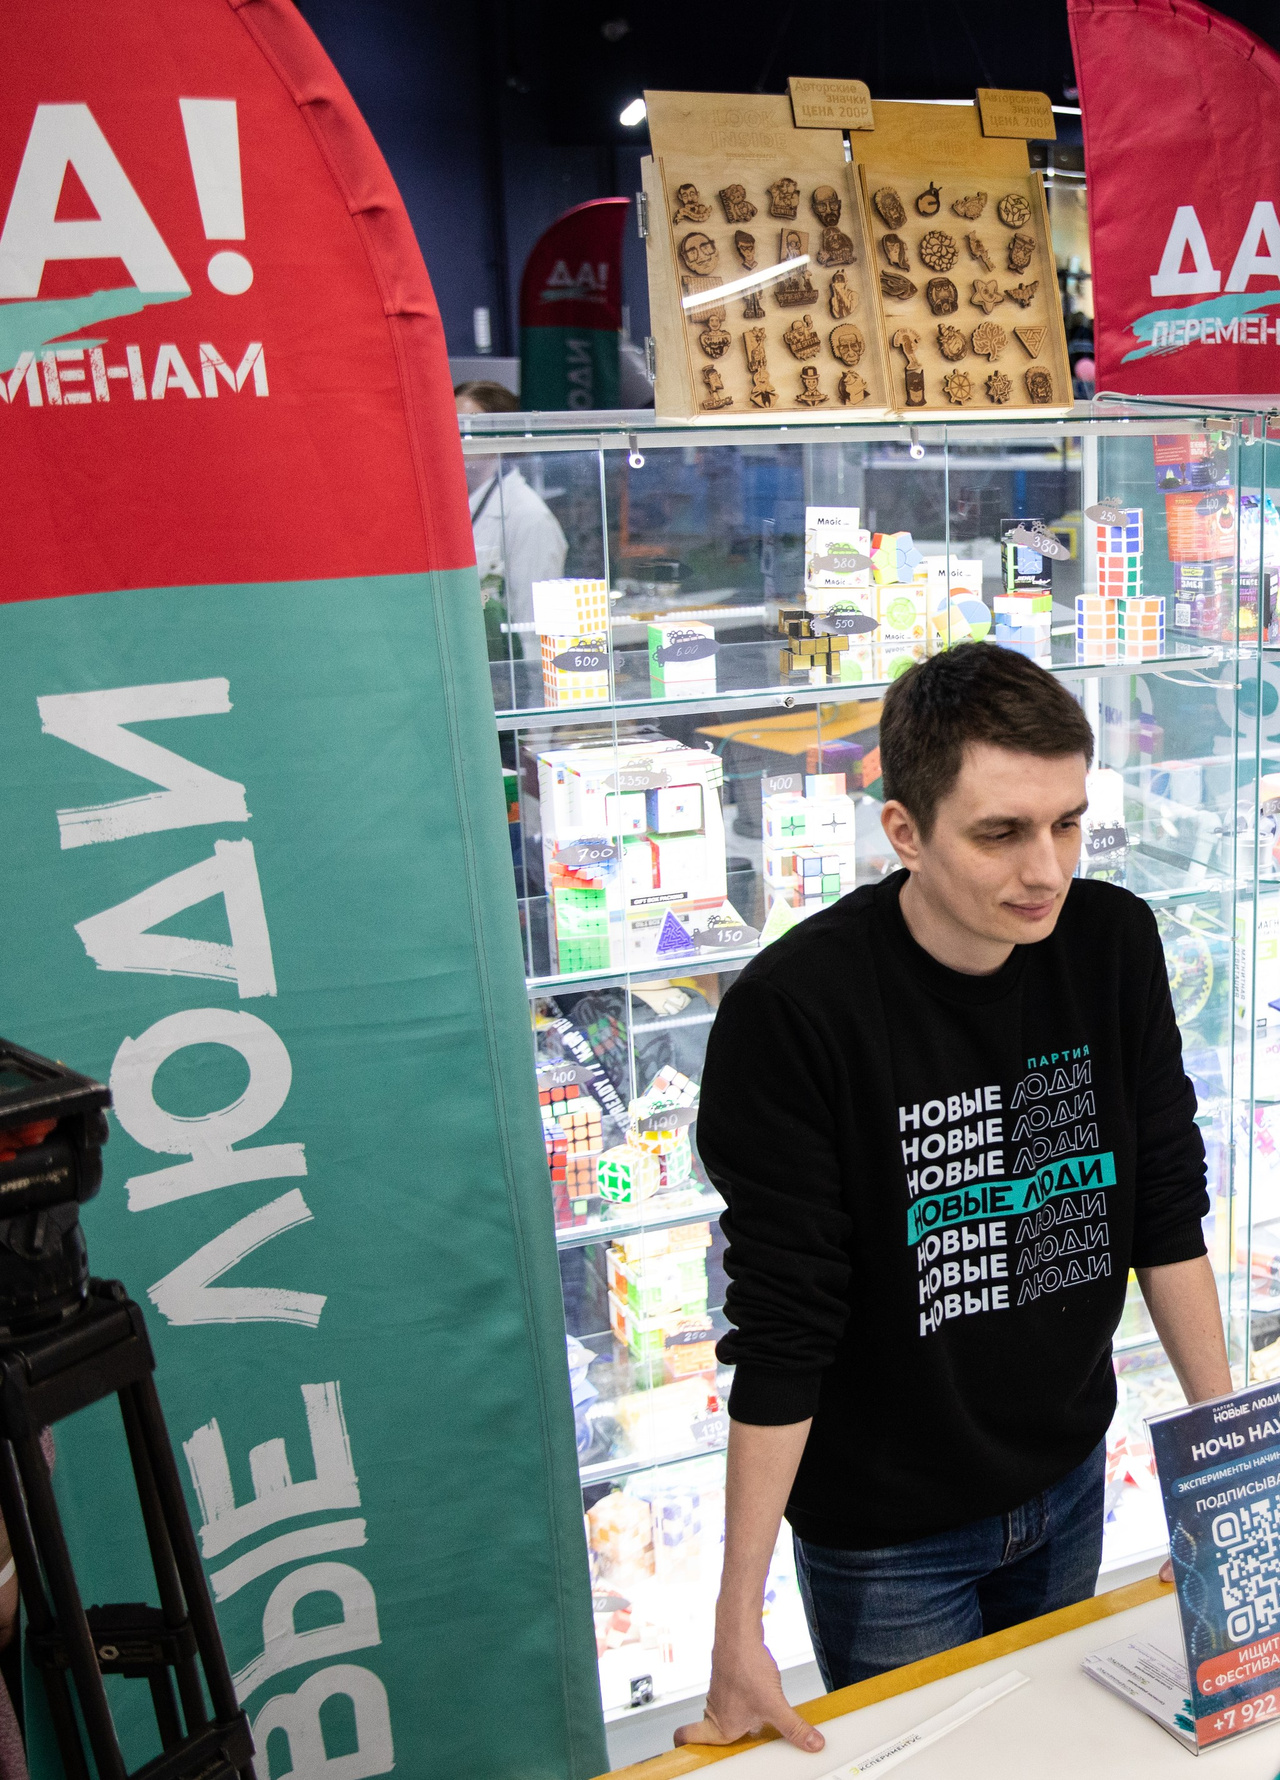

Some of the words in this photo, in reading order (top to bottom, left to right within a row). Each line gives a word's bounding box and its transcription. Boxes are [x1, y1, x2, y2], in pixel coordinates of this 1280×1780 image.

[795, 80, 857, 95] Авторские
[826, 95, 867, 105] значки
[802, 105, 834, 117] ЦЕНА
[990, 115, 1020, 128] ЦЕНА
[1100, 510, 1116, 522] 250
[1033, 536, 1058, 555] 380
[835, 619, 854, 628] 550
[769, 777, 792, 790] 400
[1093, 836, 1115, 849] 610
[577, 848, 614, 862] 700
[717, 930, 743, 943] 150
[36, 677, 327, 1328] ЛЮДИ
[1027, 1044, 1090, 1069] ПАРТИЯ
[552, 1070, 577, 1083] 400
[899, 1085, 1002, 1132] НОВЫЕ
[901, 1117, 1004, 1165] НОВЫЕ
[906, 1150, 1005, 1198] НОВЫЕ
[914, 1185, 1014, 1237] НОВЫЕ
[1022, 1158, 1103, 1208] ЛЮДИ
[917, 1221, 1007, 1272] НОВЫЕ
[1015, 1192, 1107, 1243] ЛЮДИ
[918, 1253, 1008, 1305] НОВЫЕ
[1016, 1222, 1109, 1275] ЛЮДИ
[919, 1285, 1010, 1337] НОВЫЕ
[1017, 1253, 1111, 1306] ЛЮДИ
[684, 1331, 707, 1343] 250
[1213, 1404, 1249, 1424] НОВЫЕ
[1251, 1393, 1280, 1412] ЛЮДИ
[1191, 1432, 1245, 1461] НОЧЬ
[1177, 1460, 1252, 1493] ЭКСПЕРИМЕНТЫ
[1202, 1679, 1213, 1692] С
[1213, 1712, 1235, 1731] +7
[1240, 1695, 1277, 1723] 922
